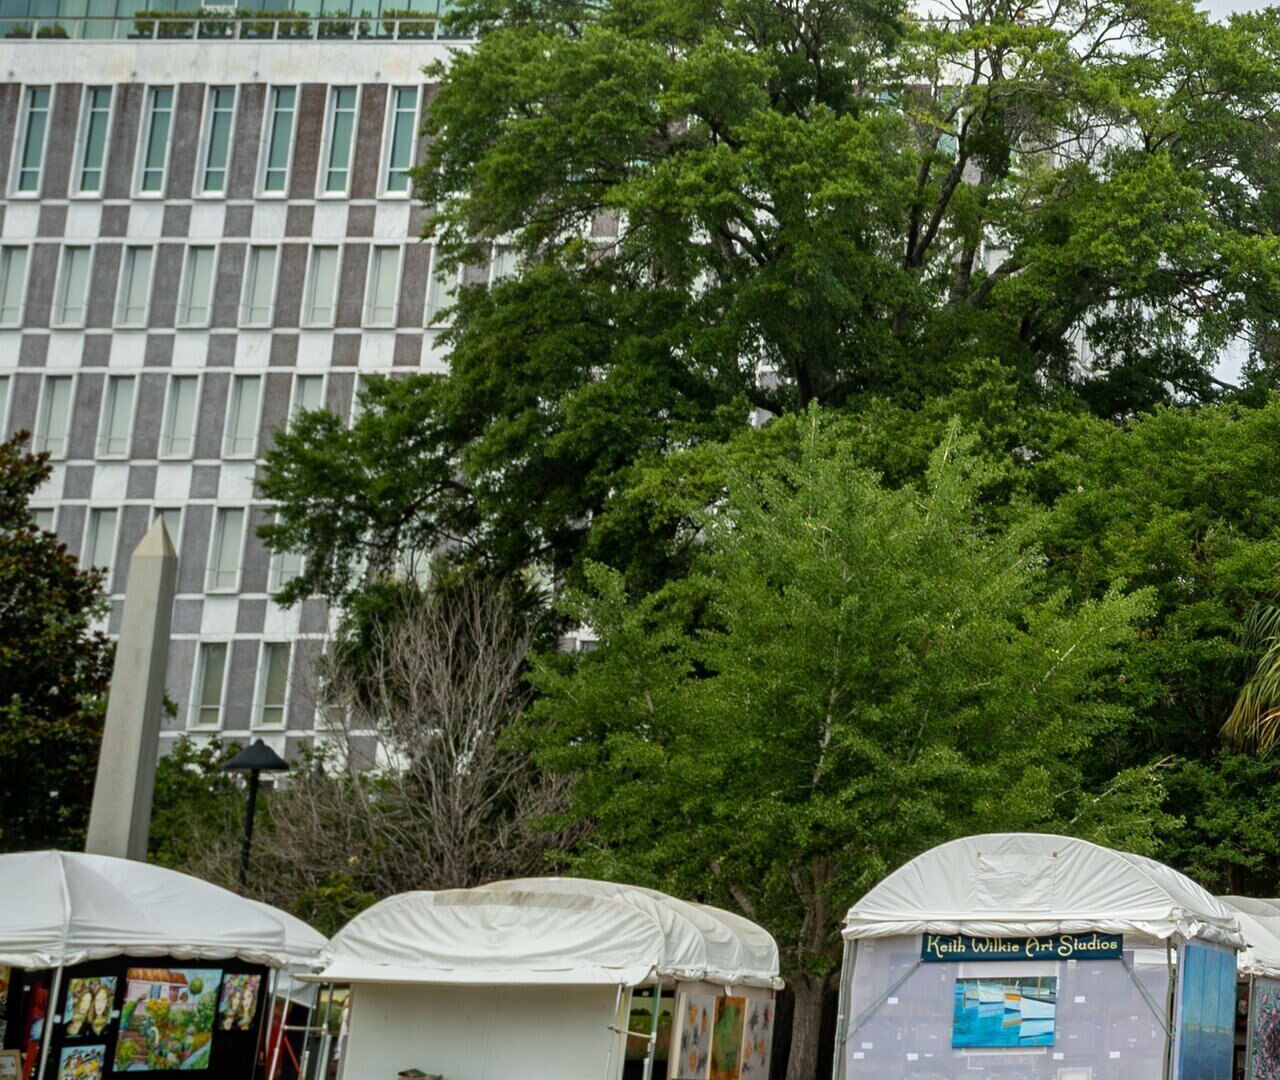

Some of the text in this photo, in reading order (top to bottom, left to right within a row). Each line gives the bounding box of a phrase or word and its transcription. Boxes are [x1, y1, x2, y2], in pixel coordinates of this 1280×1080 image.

[926, 933, 1118, 958] Keith Wilkie Art Studios
